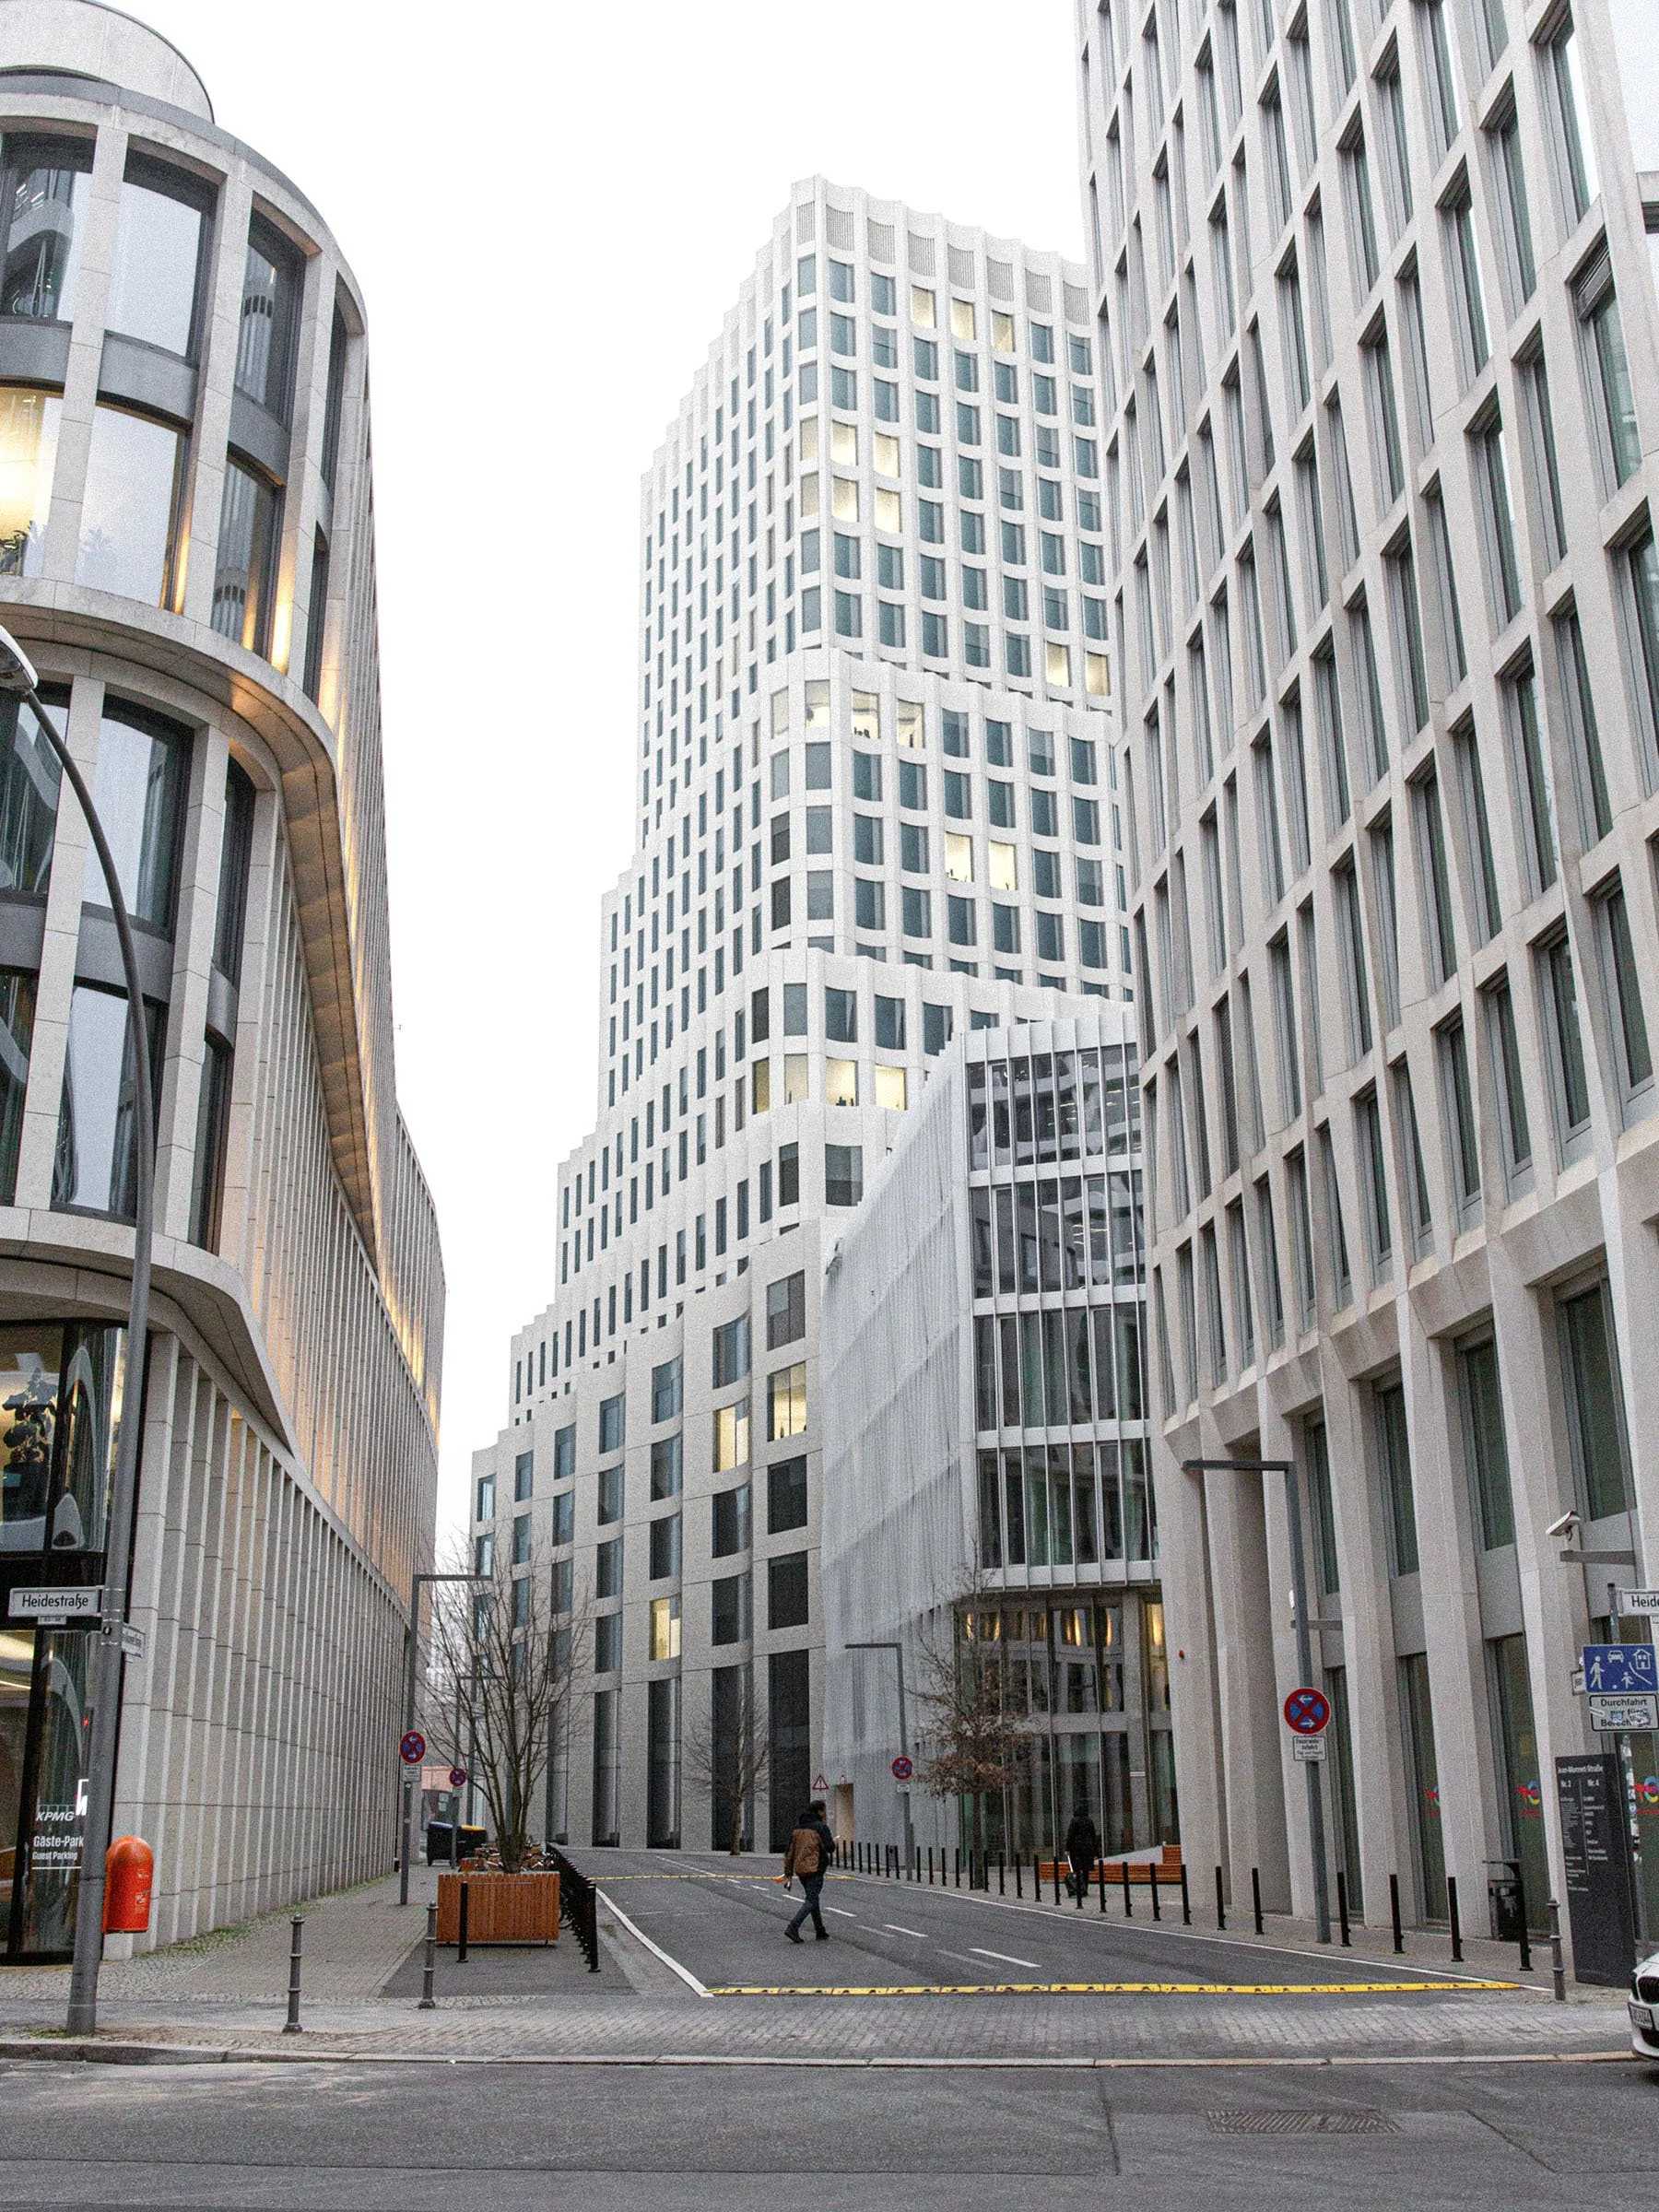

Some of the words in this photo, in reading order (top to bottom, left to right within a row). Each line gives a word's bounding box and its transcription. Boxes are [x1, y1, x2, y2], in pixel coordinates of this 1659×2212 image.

[22, 1594, 88, 1609] Heidestraße
[1600, 1698, 1647, 1707] Durchfahrt
[36, 1811, 75, 1821] KPMG
[32, 1851, 52, 1860] Guest
[53, 1851, 77, 1860] Parking
